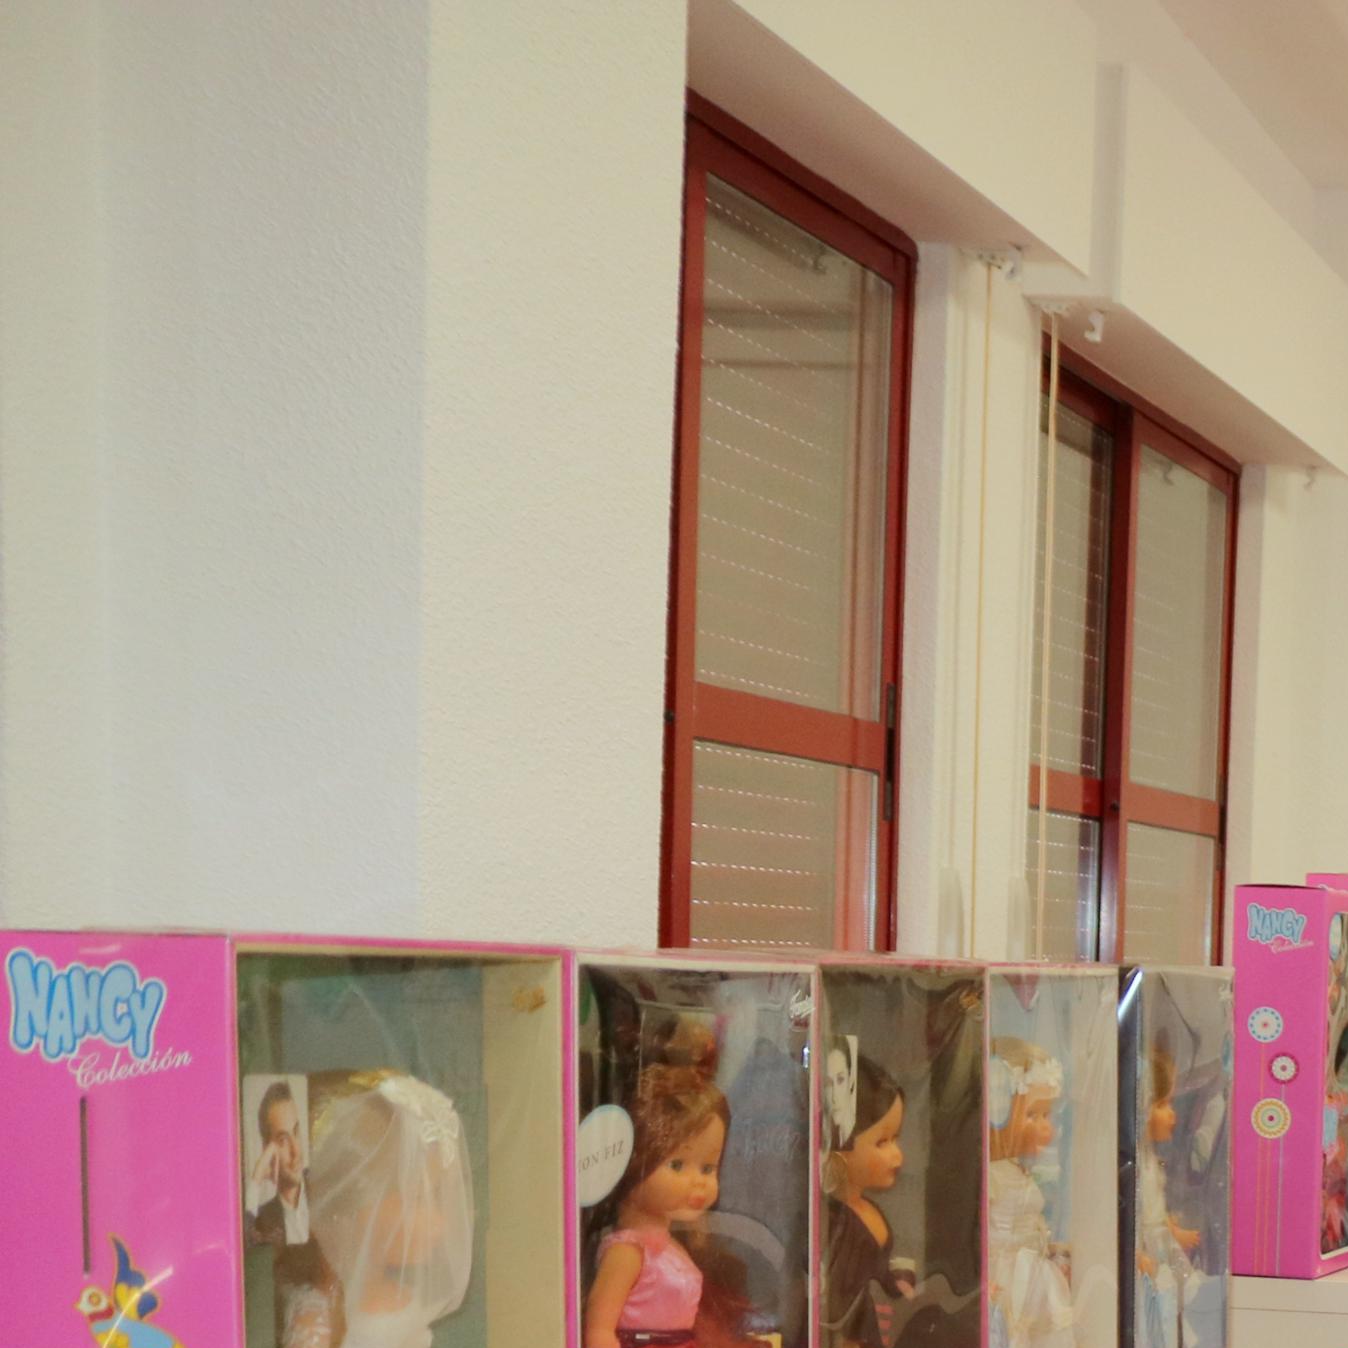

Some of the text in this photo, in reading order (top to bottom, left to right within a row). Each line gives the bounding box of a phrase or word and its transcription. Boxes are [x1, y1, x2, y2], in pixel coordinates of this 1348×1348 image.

[1246, 902, 1307, 943] NANCY
[6, 947, 166, 1060] NANCY
[70, 1050, 193, 1089] Colección
